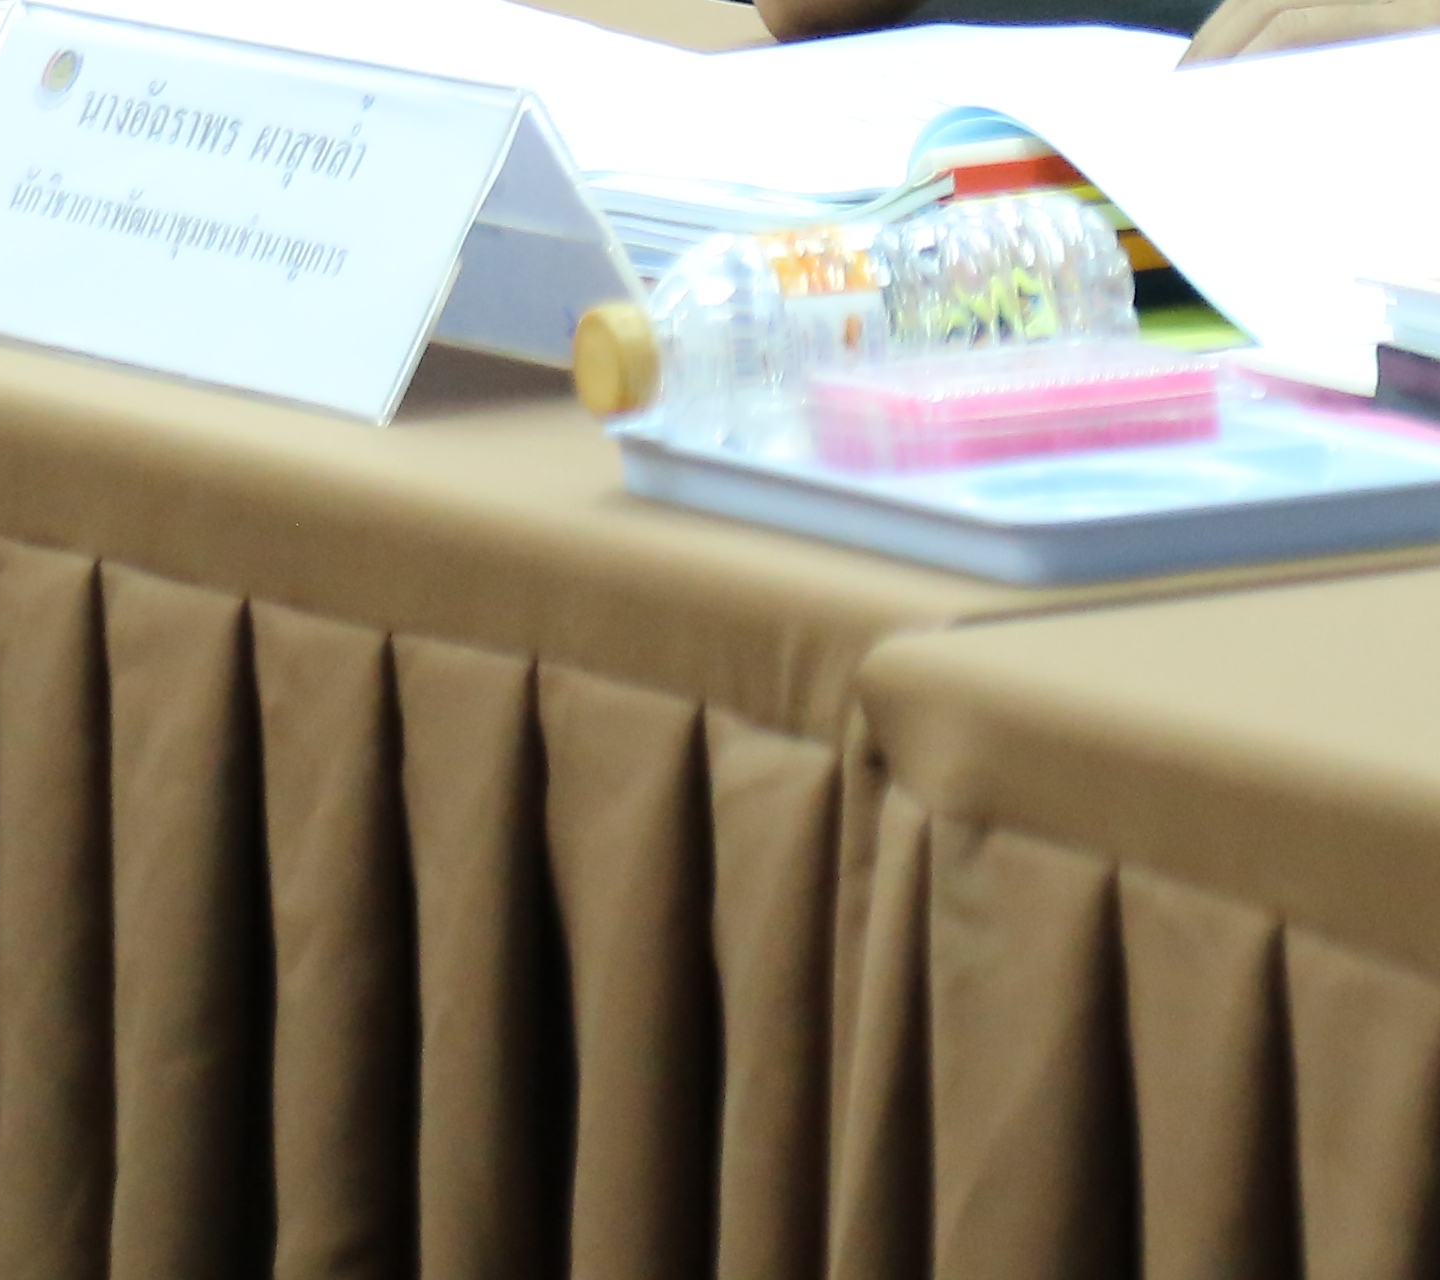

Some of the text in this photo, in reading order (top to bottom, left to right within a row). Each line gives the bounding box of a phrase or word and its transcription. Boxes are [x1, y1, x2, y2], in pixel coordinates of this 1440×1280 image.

[8, 165, 350, 282] นักวิชาการพัฒนาชุมชนชำนาญการ
